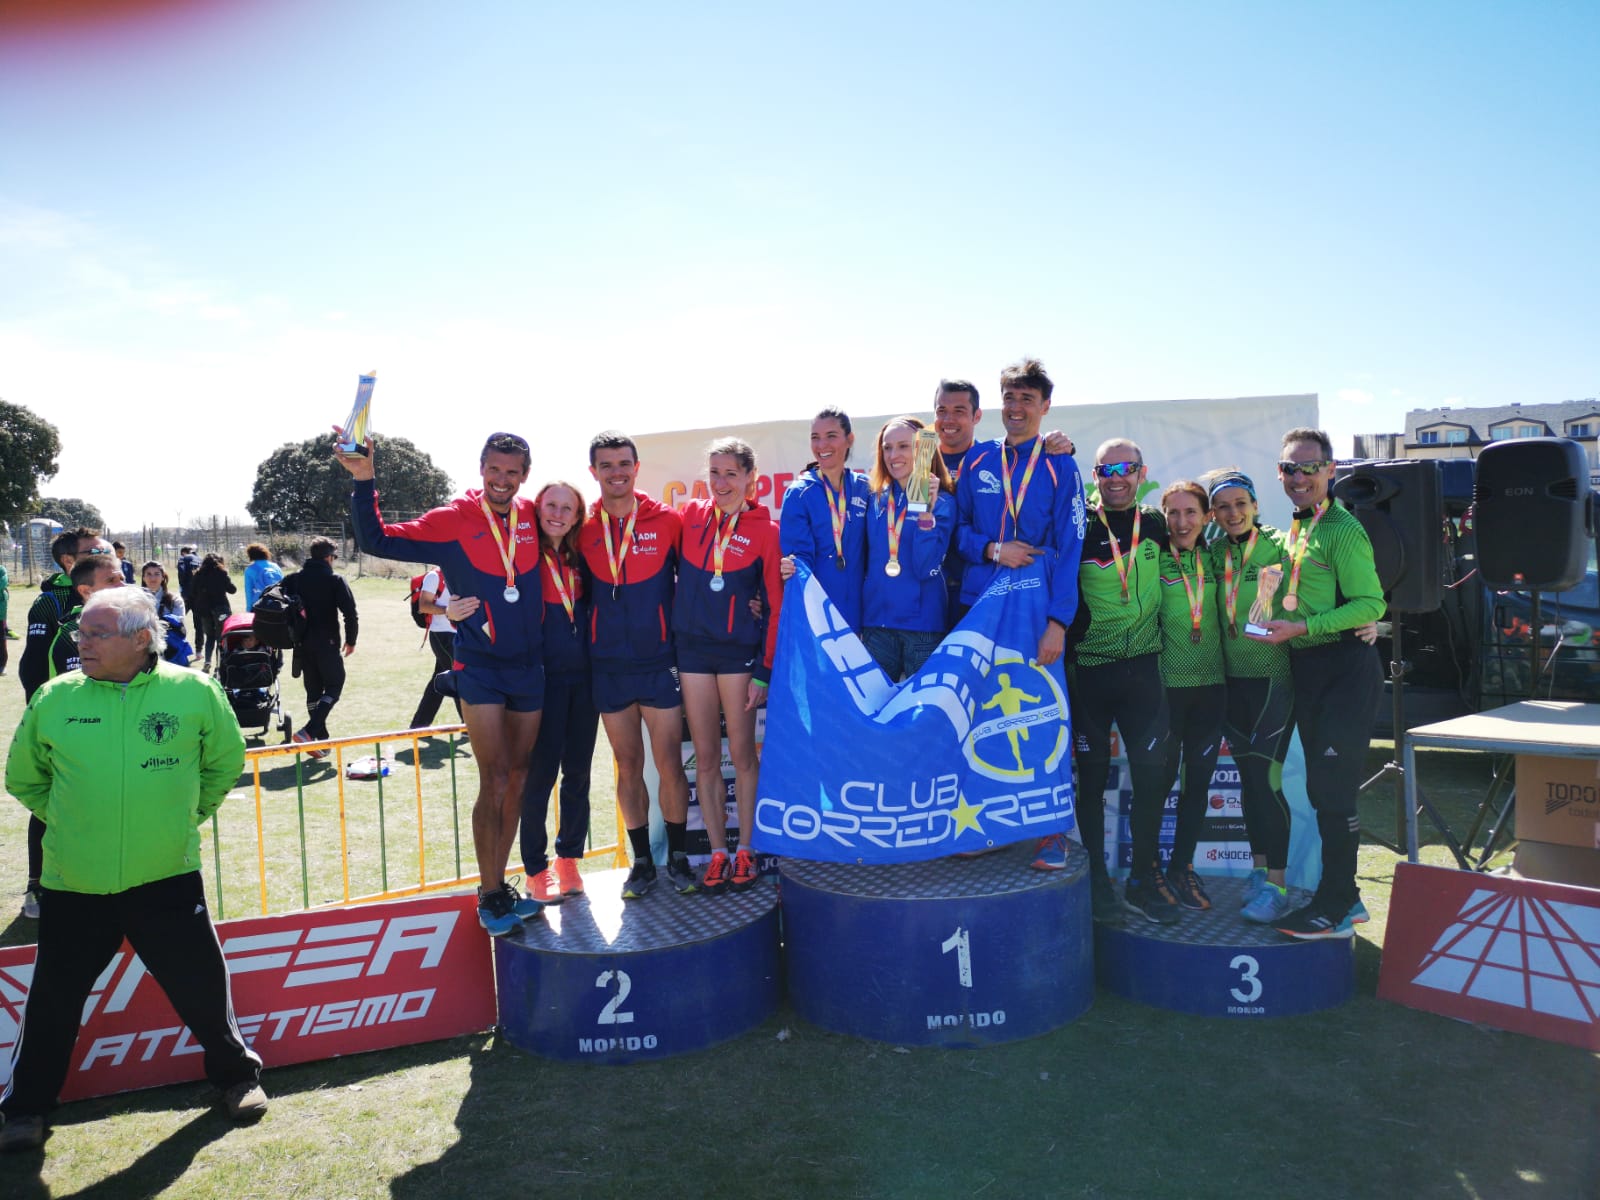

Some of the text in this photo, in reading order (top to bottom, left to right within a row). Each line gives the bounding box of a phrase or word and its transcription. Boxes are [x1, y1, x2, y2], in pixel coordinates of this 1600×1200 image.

[1504, 486, 1535, 497] EON
[731, 533, 751, 546] ADM
[840, 773, 959, 813] CLUB
[941, 926, 973, 988] 1
[1229, 954, 1263, 1004] 3
[595, 969, 635, 1025] 2
